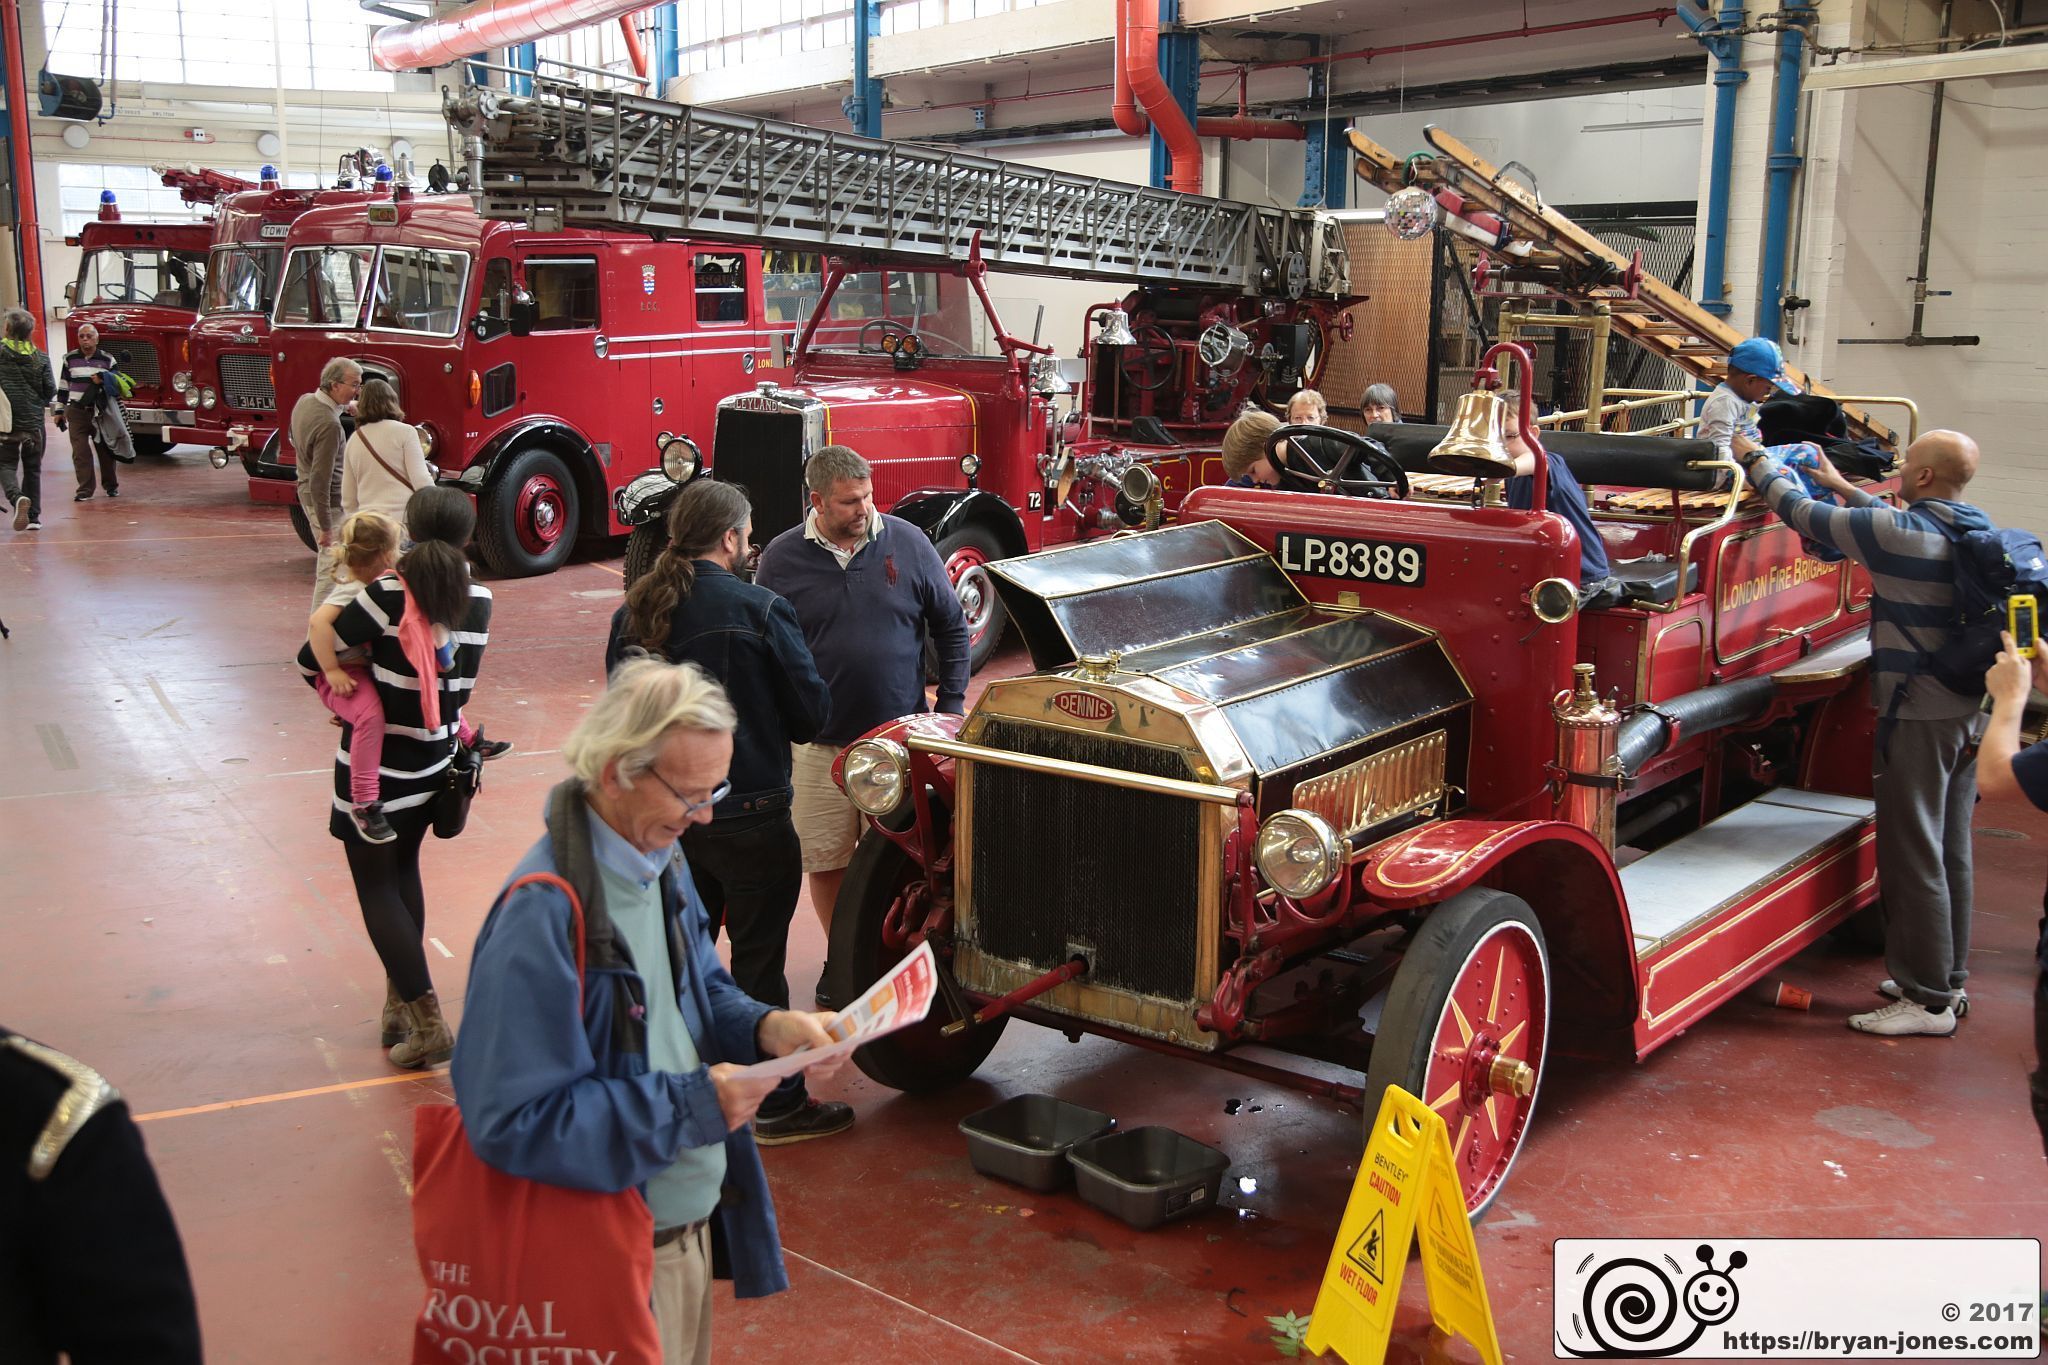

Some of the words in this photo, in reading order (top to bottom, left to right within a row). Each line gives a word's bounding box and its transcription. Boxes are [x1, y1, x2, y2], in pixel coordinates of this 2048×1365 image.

[758, 359, 773, 368] LON
[240, 396, 255, 407] 314
[256, 397, 276, 409] FLM
[736, 399, 777, 411] LEYLAND
[1028, 492, 1041, 508] 72
[1282, 536, 1420, 583] LP.8389
[1723, 574, 1768, 612] LONDON
[1769, 565, 1792, 596] FIRE
[1060, 695, 1108, 718] DENNIS
[1374, 1152, 1407, 1183] BENTLEY
[1369, 1170, 1401, 1207] CAUTION
[429, 1259, 471, 1286] THE
[1339, 1262, 1357, 1288] WET
[1356, 1273, 1378, 1306] FLOOR
[423, 1288, 567, 1340] ROYAL
